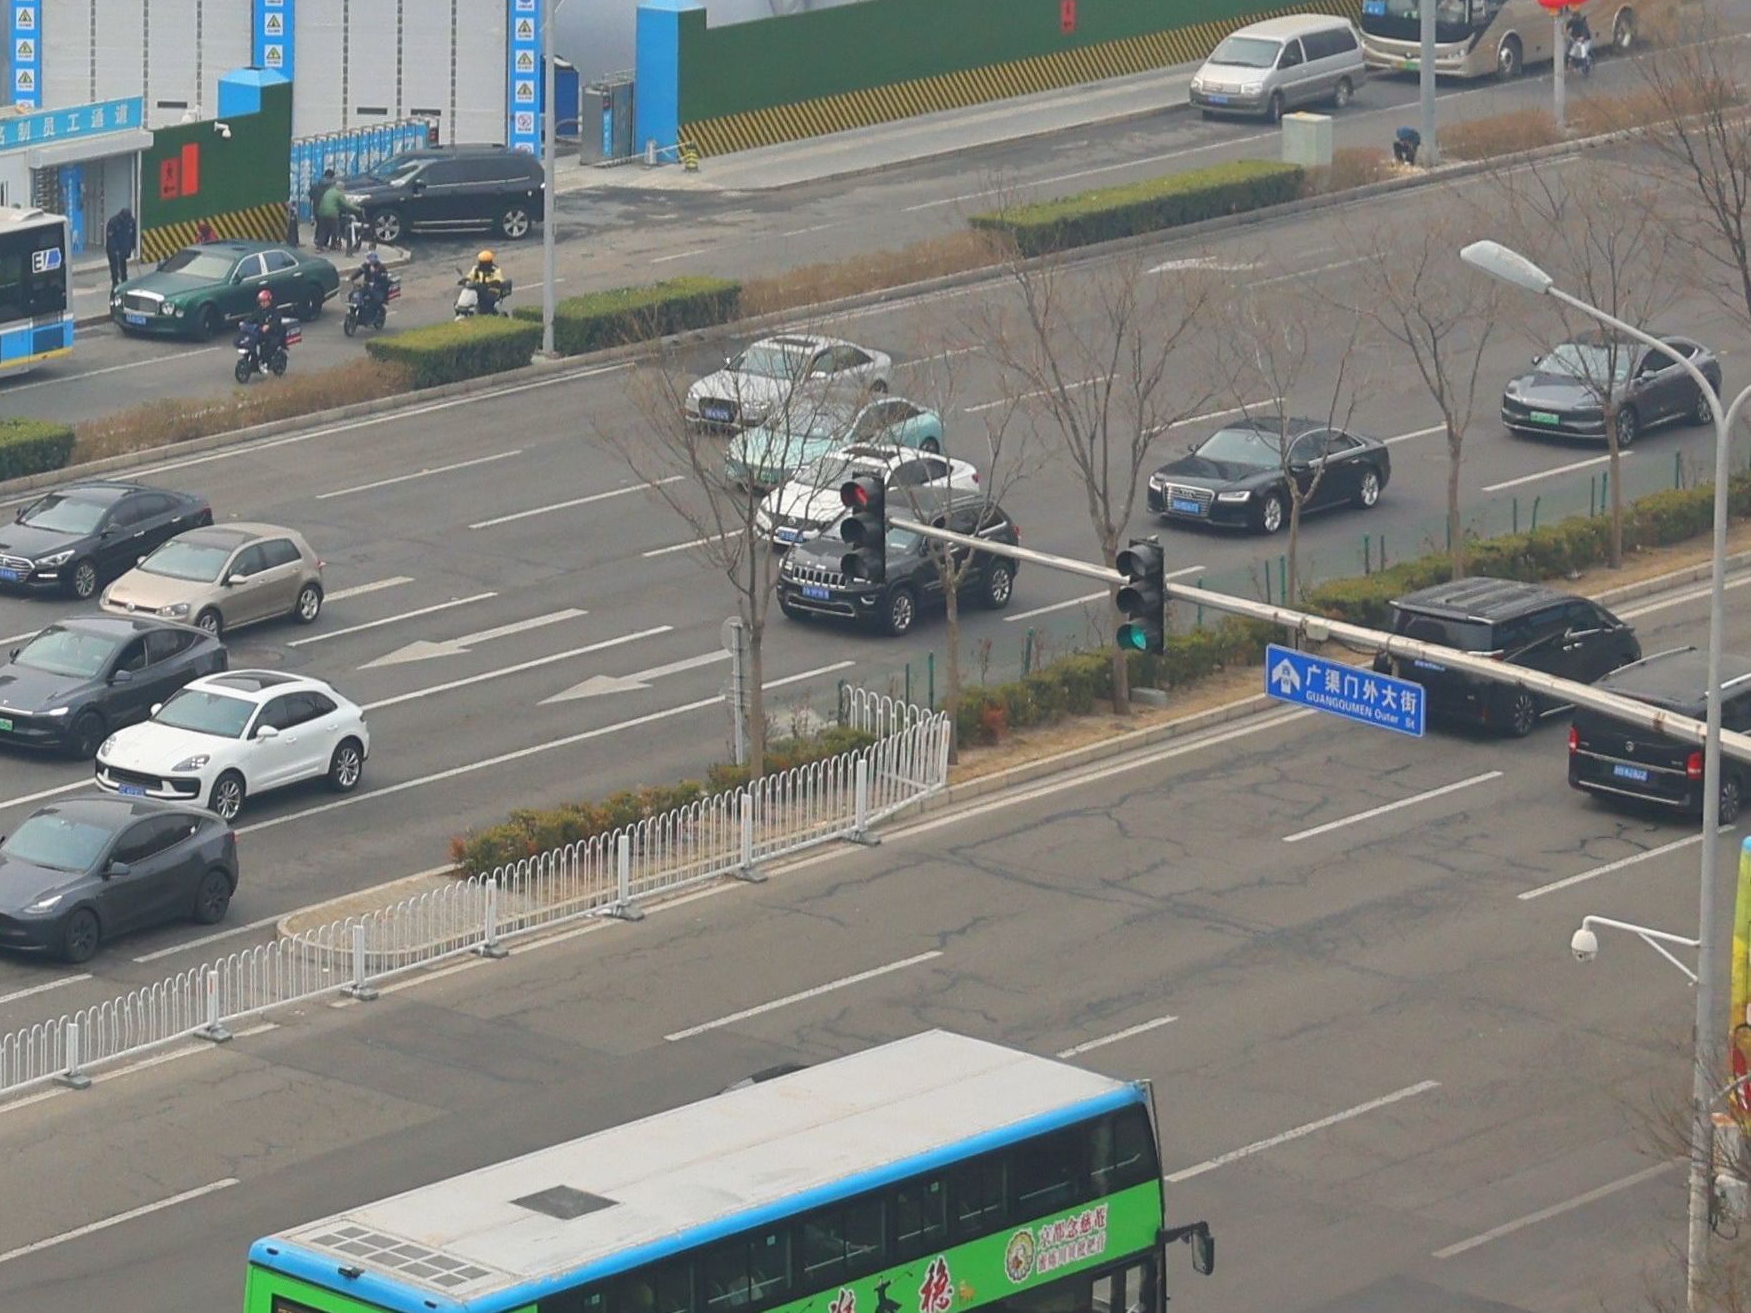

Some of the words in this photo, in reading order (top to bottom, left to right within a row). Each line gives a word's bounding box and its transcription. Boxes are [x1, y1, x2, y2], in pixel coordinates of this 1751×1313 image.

[1305, 664, 1418, 716] 广渠门外大街
[1305, 690, 1373, 718] GUANGQUMEN
[1374, 707, 1400, 725] Outer
